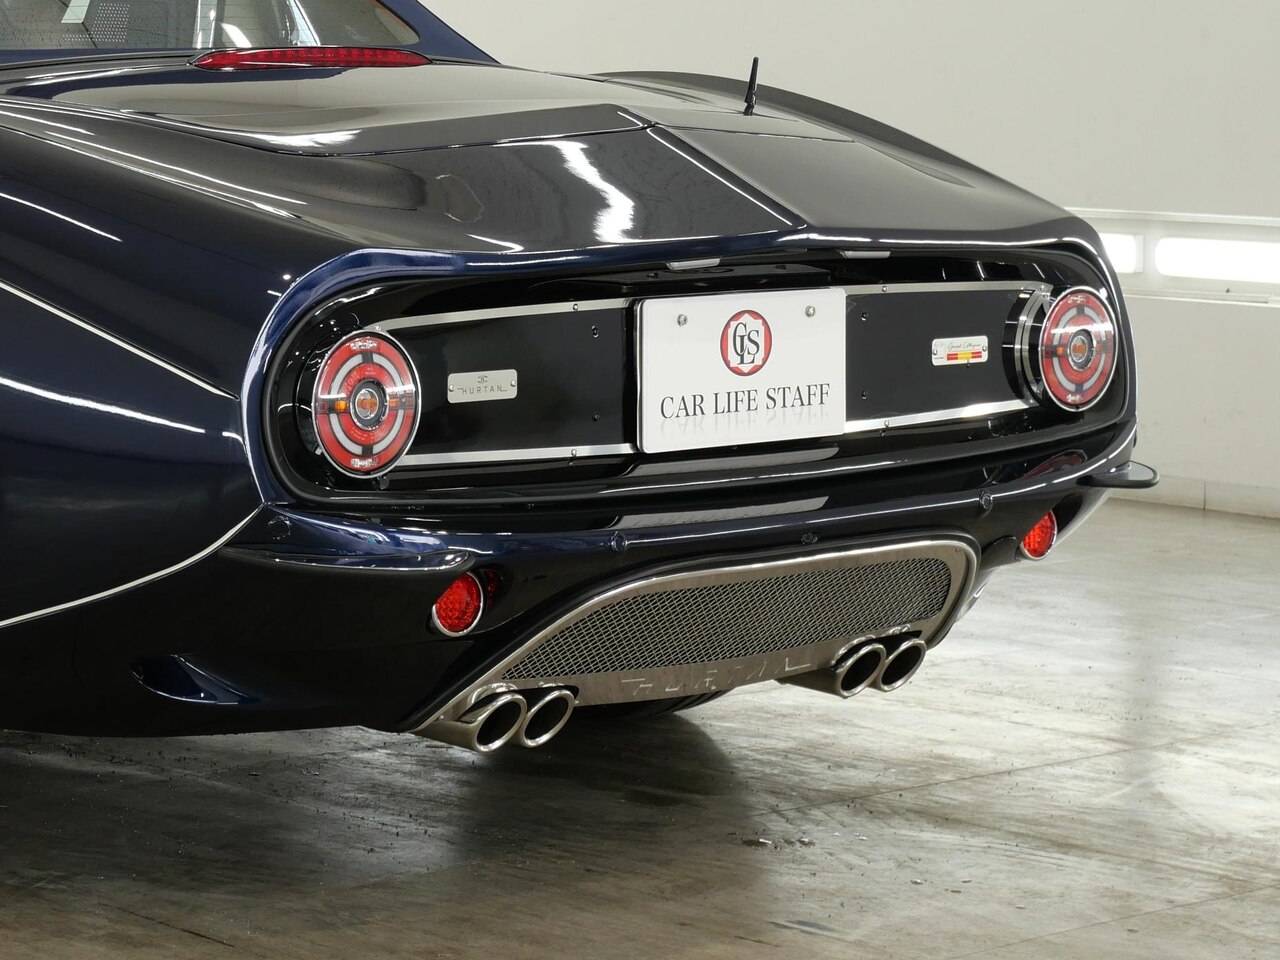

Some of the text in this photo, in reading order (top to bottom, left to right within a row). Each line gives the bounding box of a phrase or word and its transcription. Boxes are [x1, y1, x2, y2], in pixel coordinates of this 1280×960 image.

[732, 321, 761, 366] CLS
[457, 384, 508, 396] HURTAN
[660, 383, 831, 419] CAR LIFE STAFF
